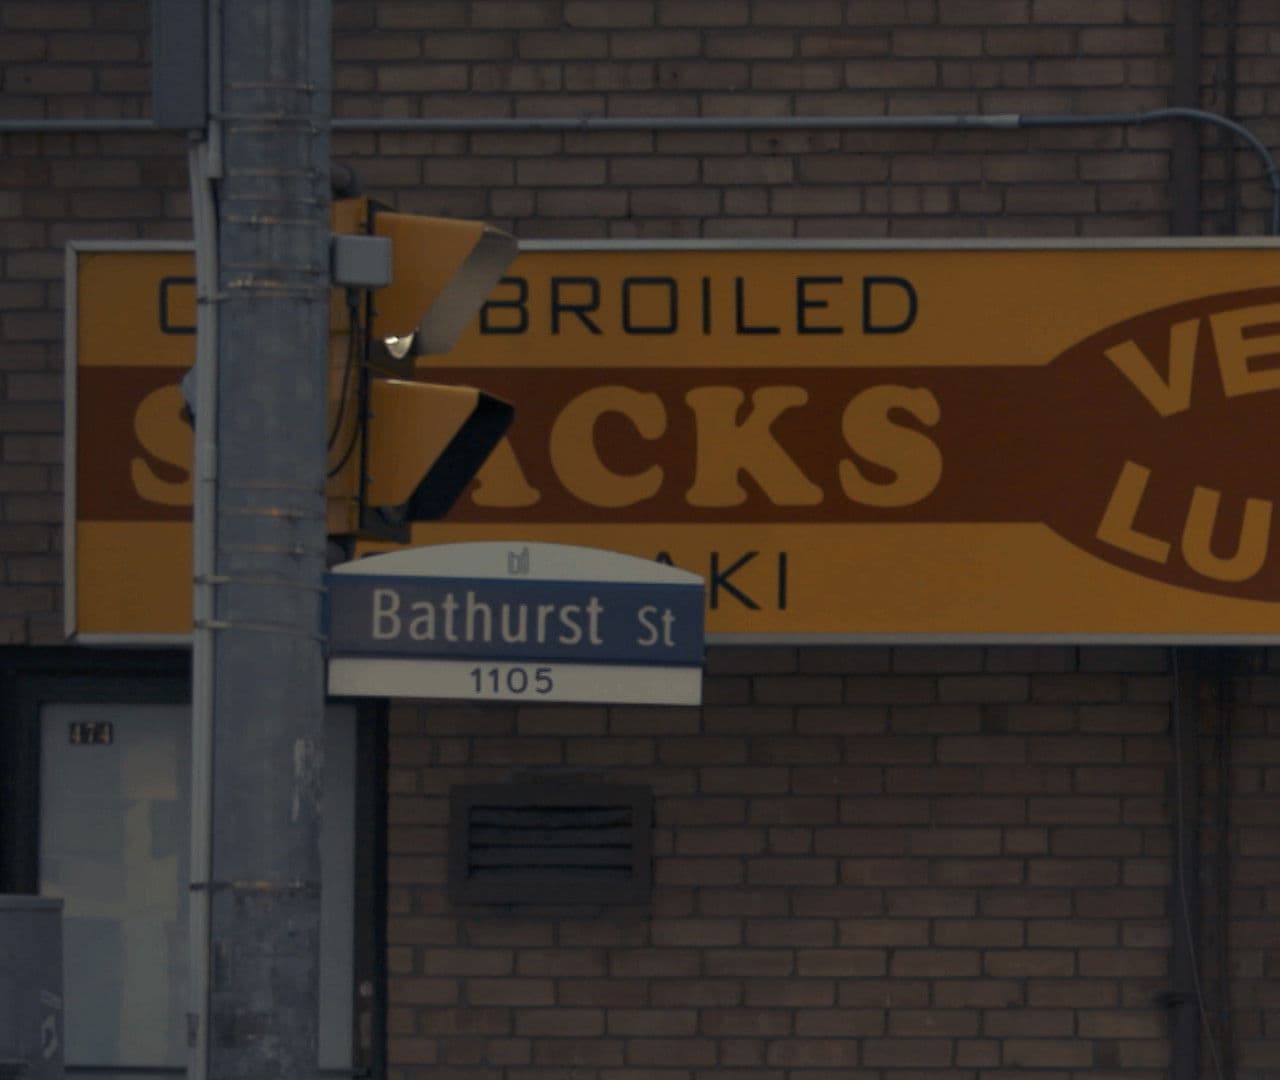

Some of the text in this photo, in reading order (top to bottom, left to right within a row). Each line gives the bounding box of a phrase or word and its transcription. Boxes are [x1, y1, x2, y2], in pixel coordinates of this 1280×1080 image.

[372, 588, 676, 647] Bathurst St
[470, 667, 554, 694] 1105
